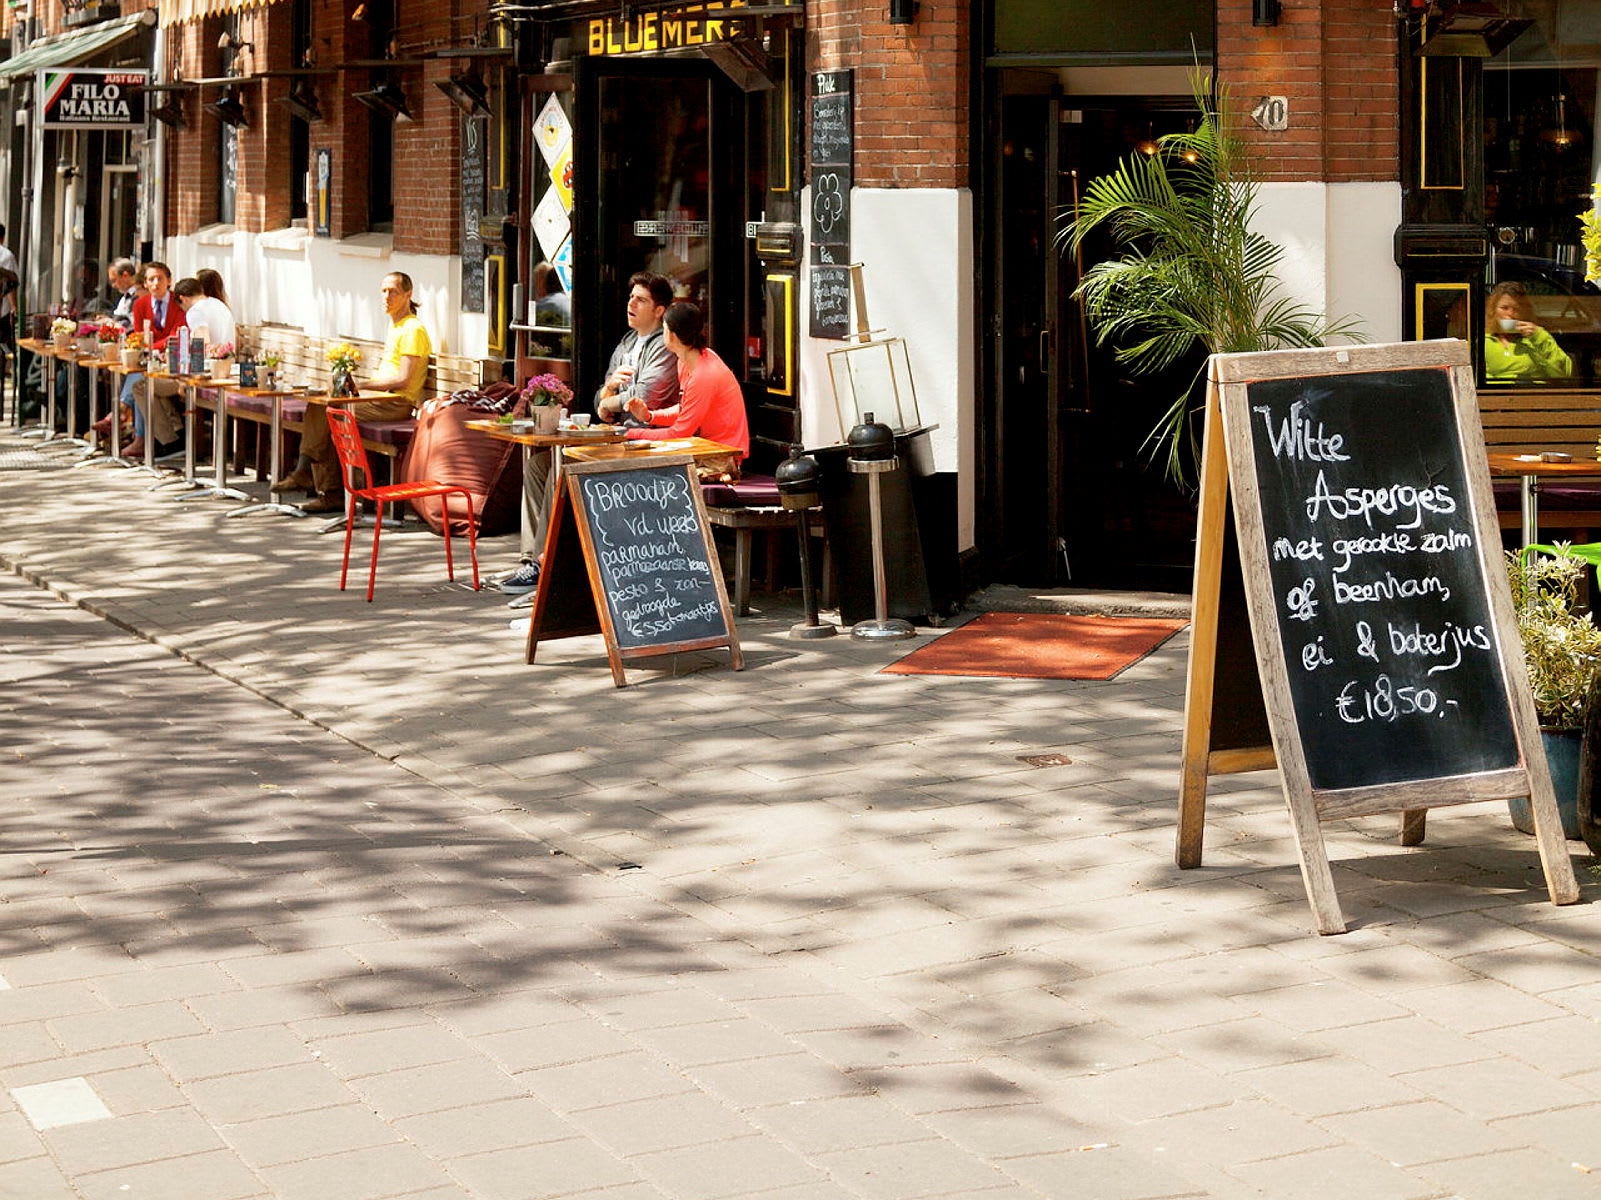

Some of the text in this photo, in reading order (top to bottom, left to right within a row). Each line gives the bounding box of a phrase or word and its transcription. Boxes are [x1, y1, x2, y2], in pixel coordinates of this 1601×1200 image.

[71, 83, 120, 100] FILO
[104, 74, 144, 84] JUST EAT
[60, 99, 131, 116] MARIA
[1253, 400, 1351, 461] Witte
[1306, 469, 1456, 531] Asperges
[1273, 536, 1325, 561] met
[1421, 528, 1472, 553] zalm
[608, 583, 649, 615] pesto
[1287, 571, 1450, 621] of beenham,
[1302, 620, 1491, 677] ei & boterjus
